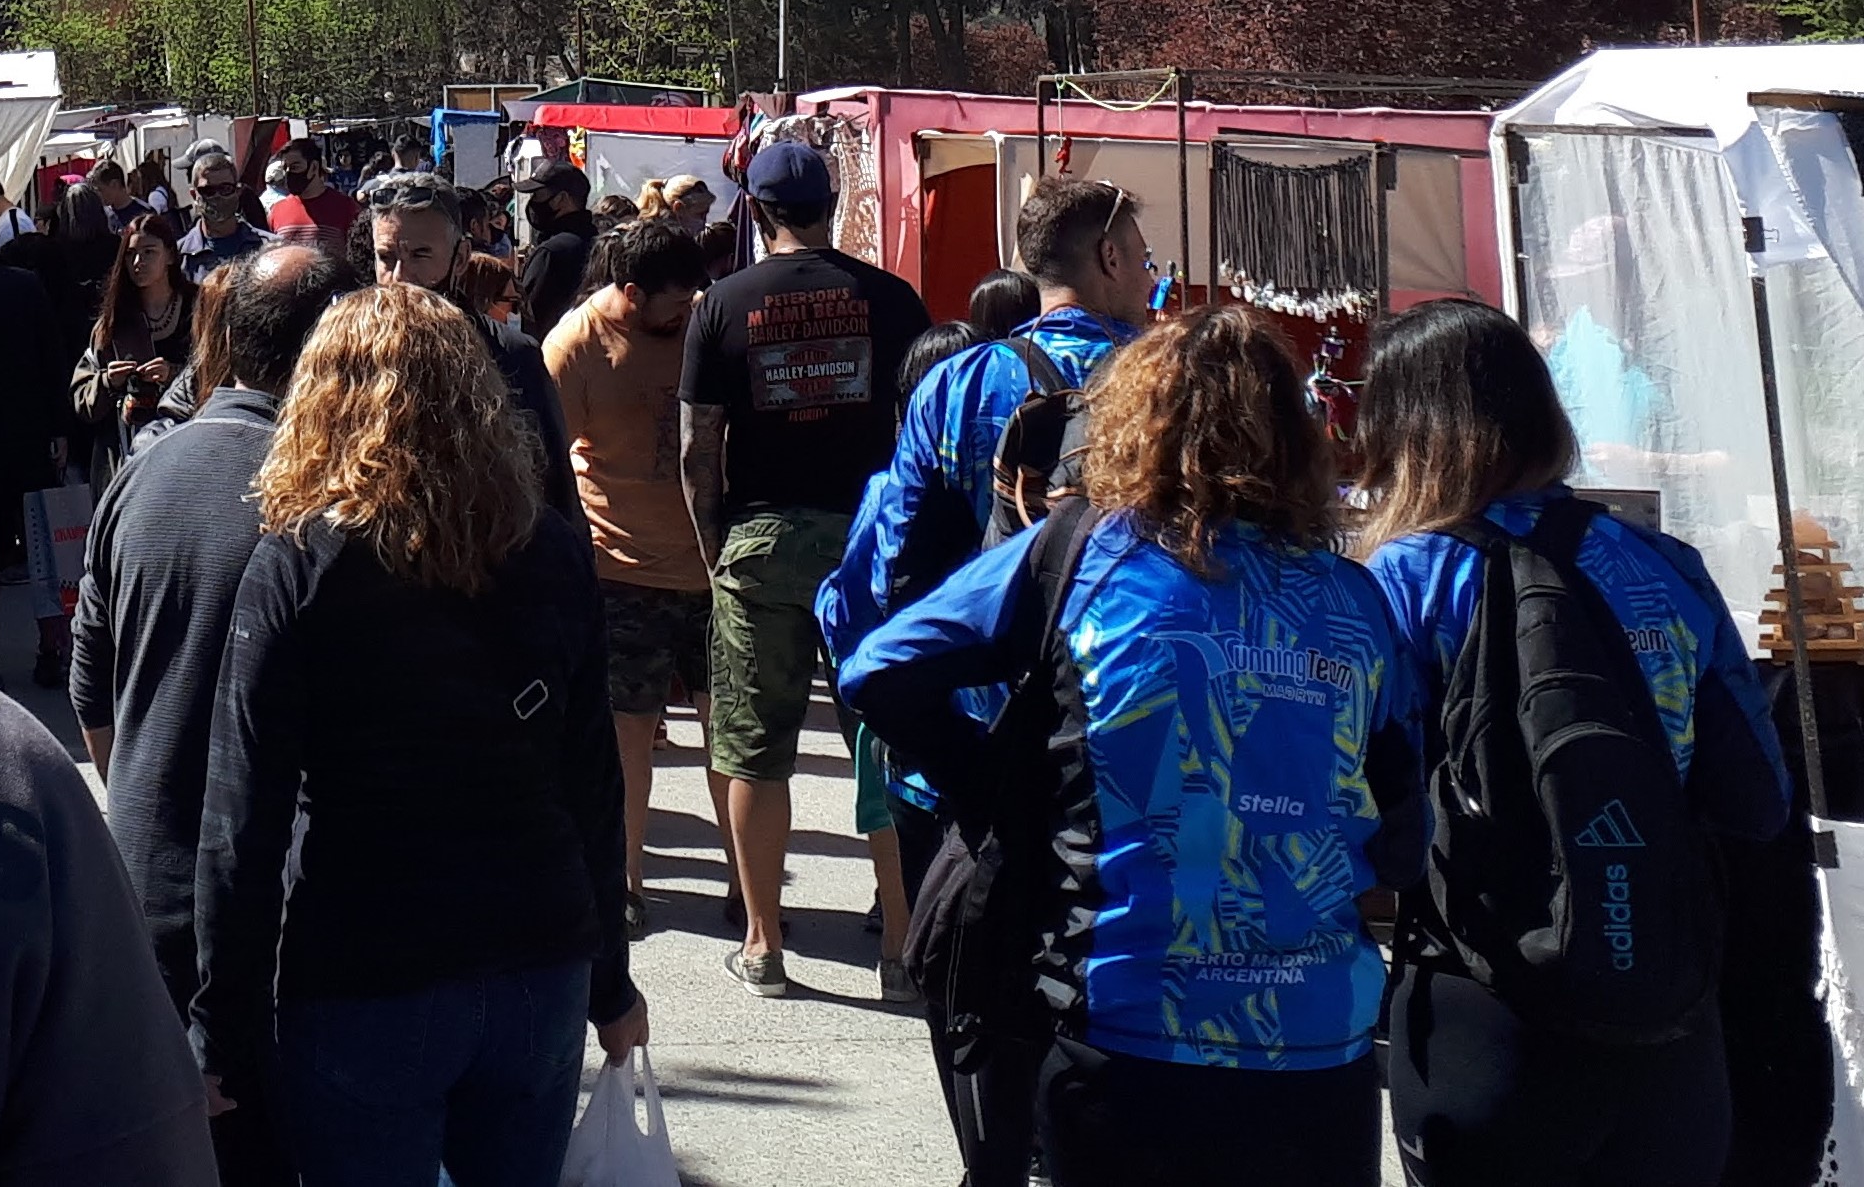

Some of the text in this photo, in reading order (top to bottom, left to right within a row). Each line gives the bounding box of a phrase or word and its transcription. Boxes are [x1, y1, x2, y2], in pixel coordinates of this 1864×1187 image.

[764, 287, 850, 307] PETERSON'S
[747, 299, 870, 328] MIAMI BEACH
[748, 316, 869, 344] HARLEY-DAVIDSON
[765, 361, 855, 382] HARLEY-DAVIDSON
[1263, 683, 1326, 706] MADRYN
[1600, 863, 1634, 971] adidas
[1195, 967, 1306, 984] ARGENTINA
